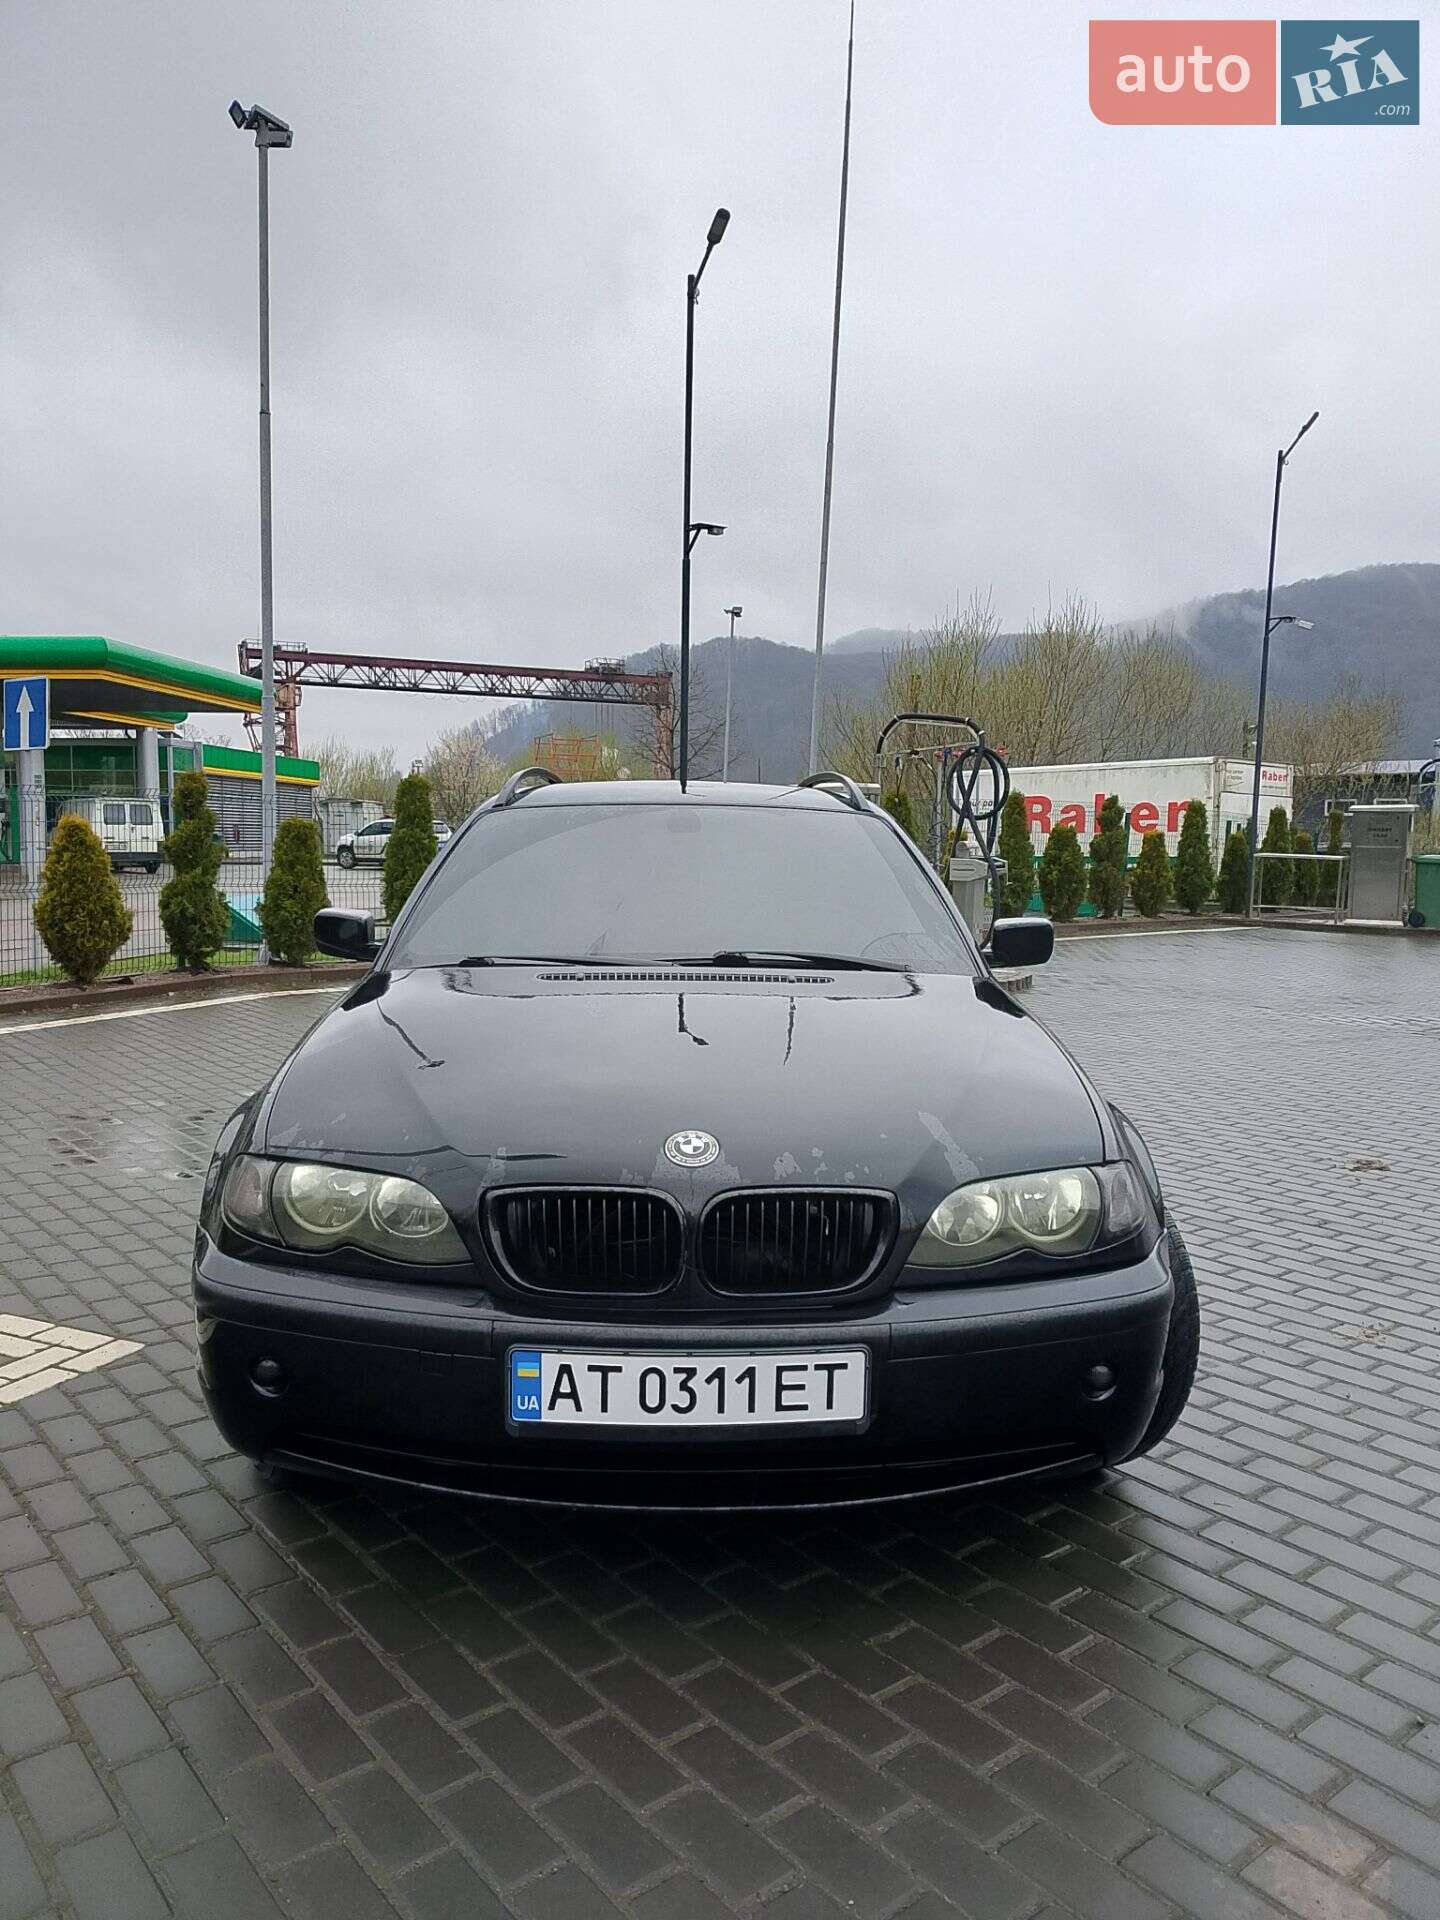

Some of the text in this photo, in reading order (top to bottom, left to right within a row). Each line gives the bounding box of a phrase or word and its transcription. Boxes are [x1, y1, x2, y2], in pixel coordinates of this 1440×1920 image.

[1261, 770, 1289, 783] Raben
[547, 1362, 849, 1415] AT 0311 ET
[517, 1395, 540, 1410] UA
